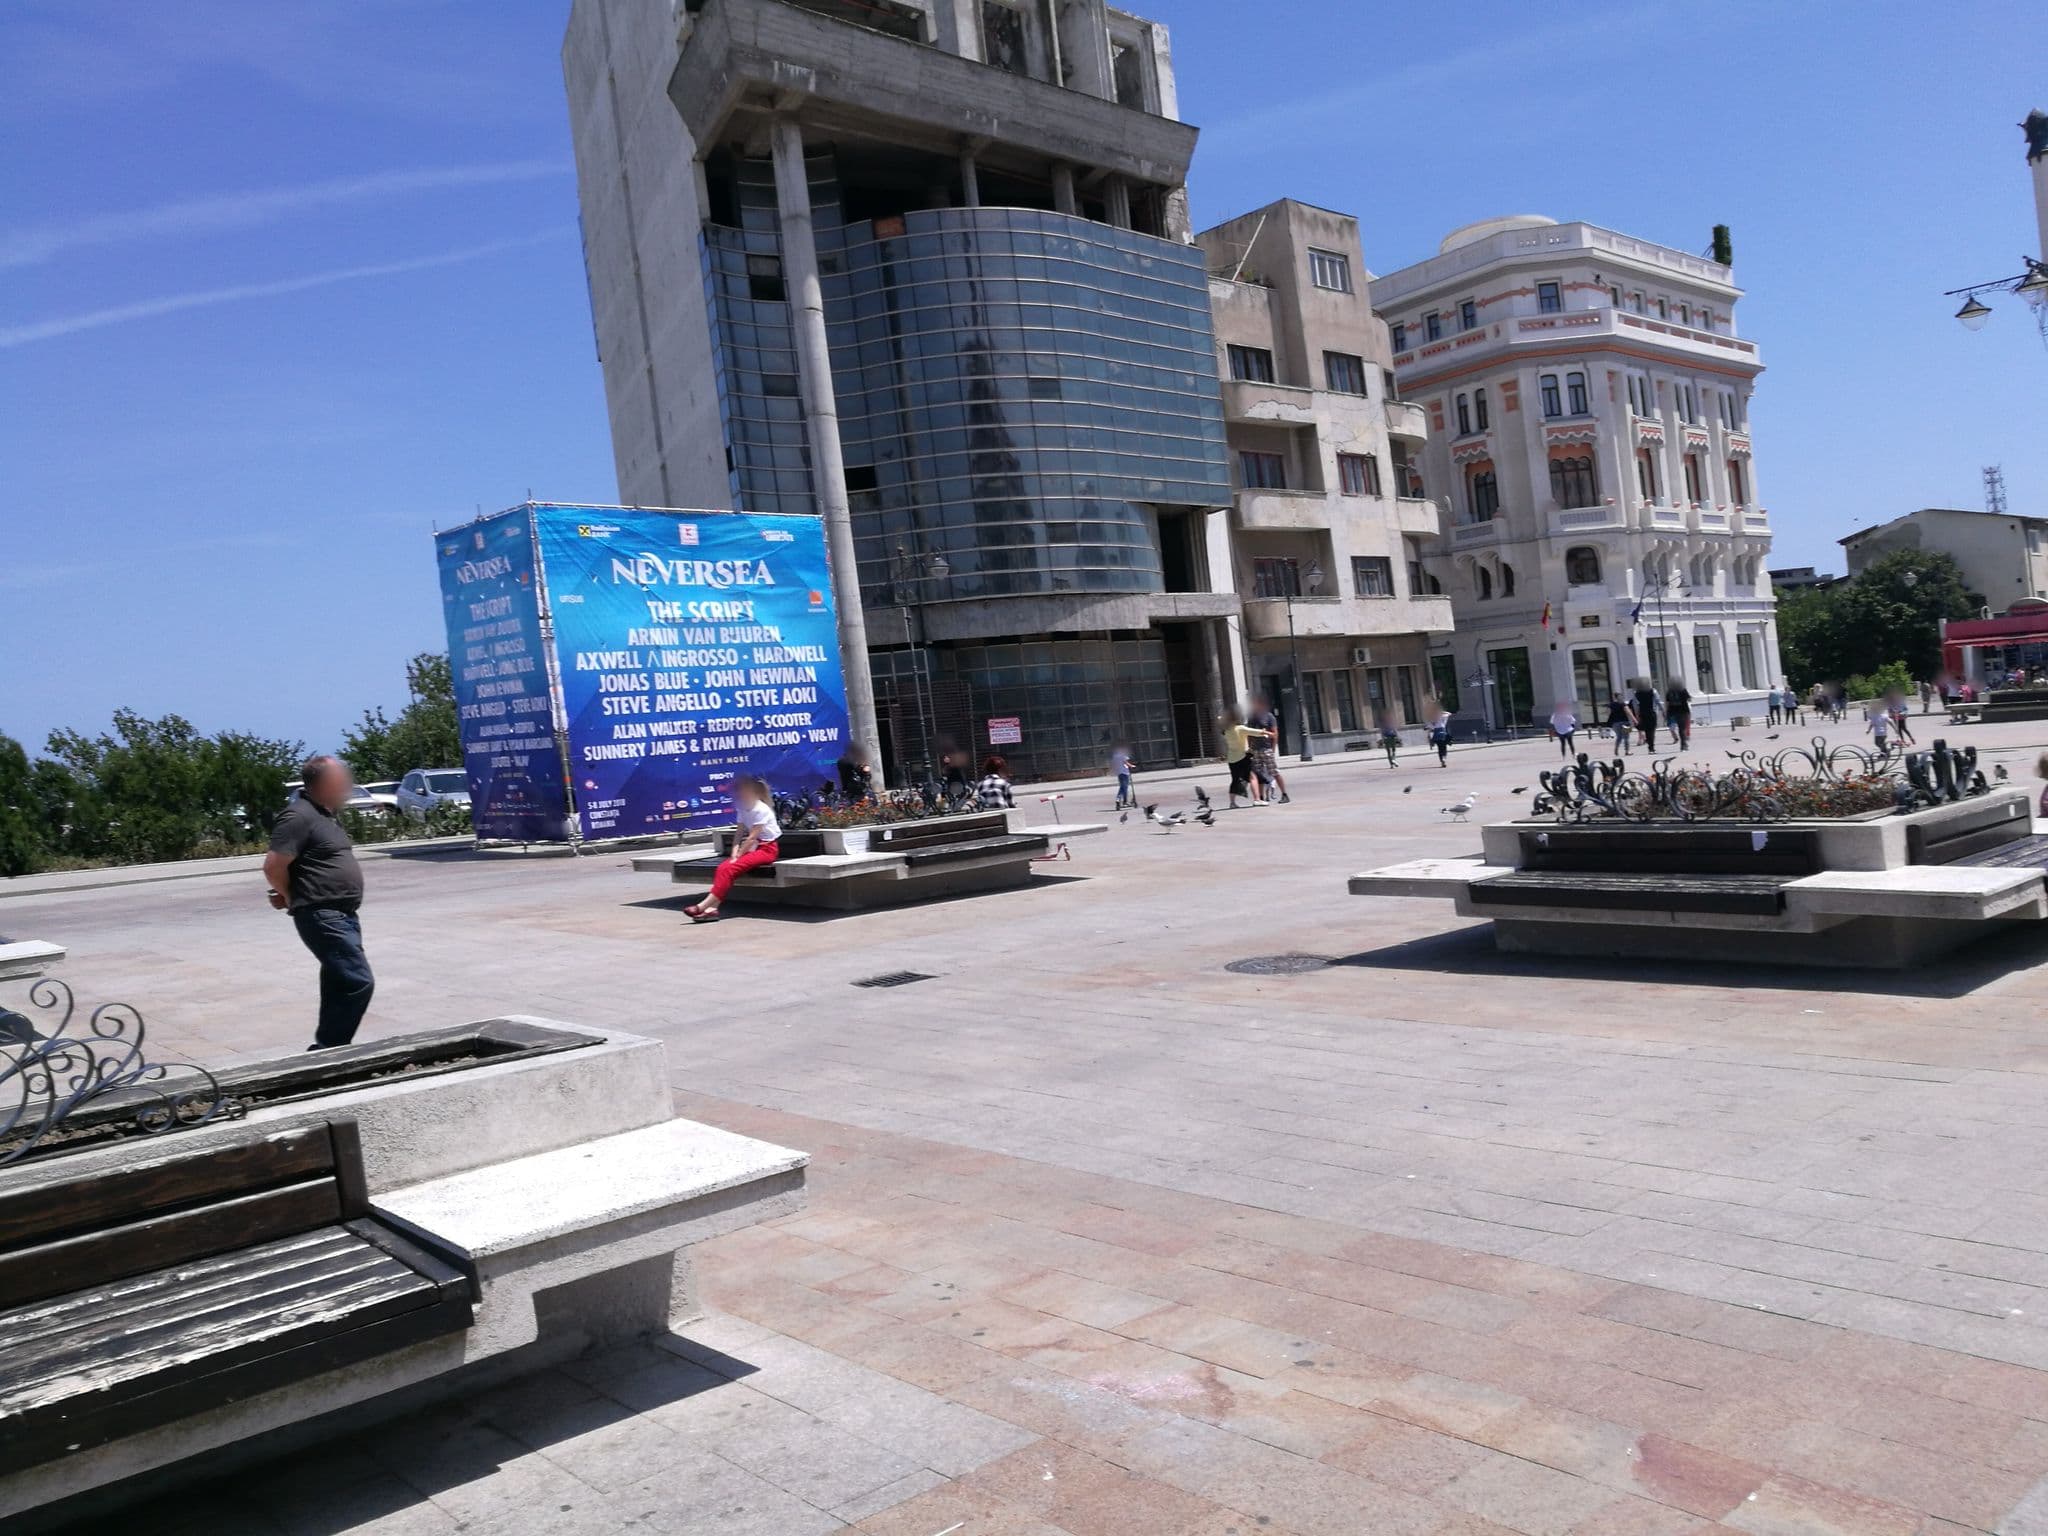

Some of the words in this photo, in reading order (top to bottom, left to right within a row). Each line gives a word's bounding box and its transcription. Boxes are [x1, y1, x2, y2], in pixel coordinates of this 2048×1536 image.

[611, 552, 776, 590] NEVERSEA
[647, 601, 683, 623] THE
[688, 600, 755, 622] SCRIPT
[628, 628, 679, 646] ARMIN
[685, 627, 717, 645] VAN
[576, 651, 642, 671] AXWELL
[662, 649, 738, 667] INGROSSO
[753, 645, 828, 664] HARDWELL
[599, 673, 649, 694] JONAS
[655, 672, 690, 690] BLUE
[704, 669, 745, 688] JOHN
[751, 666, 817, 685] NEWMAN
[602, 696, 650, 716] STEVE
[655, 692, 720, 713] ANGELLO
[736, 690, 780, 708] STEVE
[783, 687, 817, 705] AOKI
[613, 723, 647, 740] ALAN
[650, 720, 697, 737] WALKER
[707, 716, 753, 732] REDFOO
[764, 712, 812, 729] SCOOTER
[583, 743, 646, 761] SUNNERY
[650, 740, 687, 756] JAMES
[690, 738, 700, 752] &
[703, 736, 735, 752] RYAN
[738, 731, 800, 749] MARCIANO
[808, 727, 838, 744] W&W
[701, 757, 723, 766] MANY
[727, 756, 749, 764] MORE
